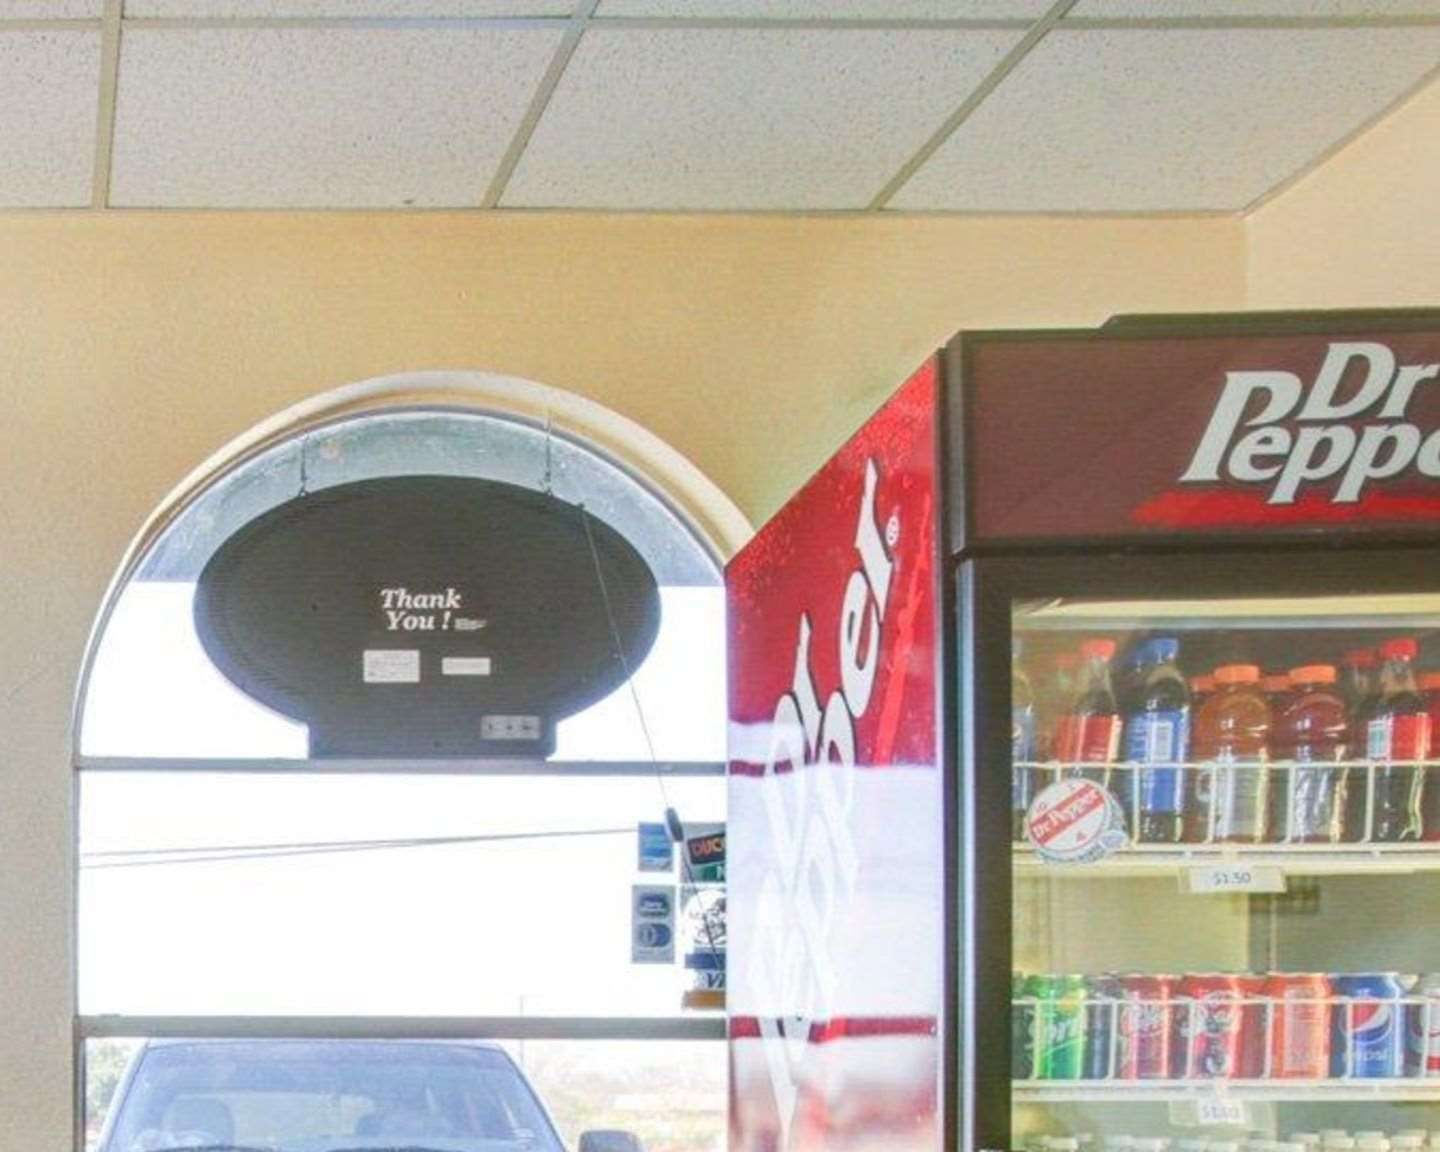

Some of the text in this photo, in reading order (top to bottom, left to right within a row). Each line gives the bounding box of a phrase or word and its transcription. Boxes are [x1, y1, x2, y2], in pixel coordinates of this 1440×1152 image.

[1296, 341, 1440, 421] Dr
[380, 587, 461, 609] Thank
[386, 610, 435, 631] You
